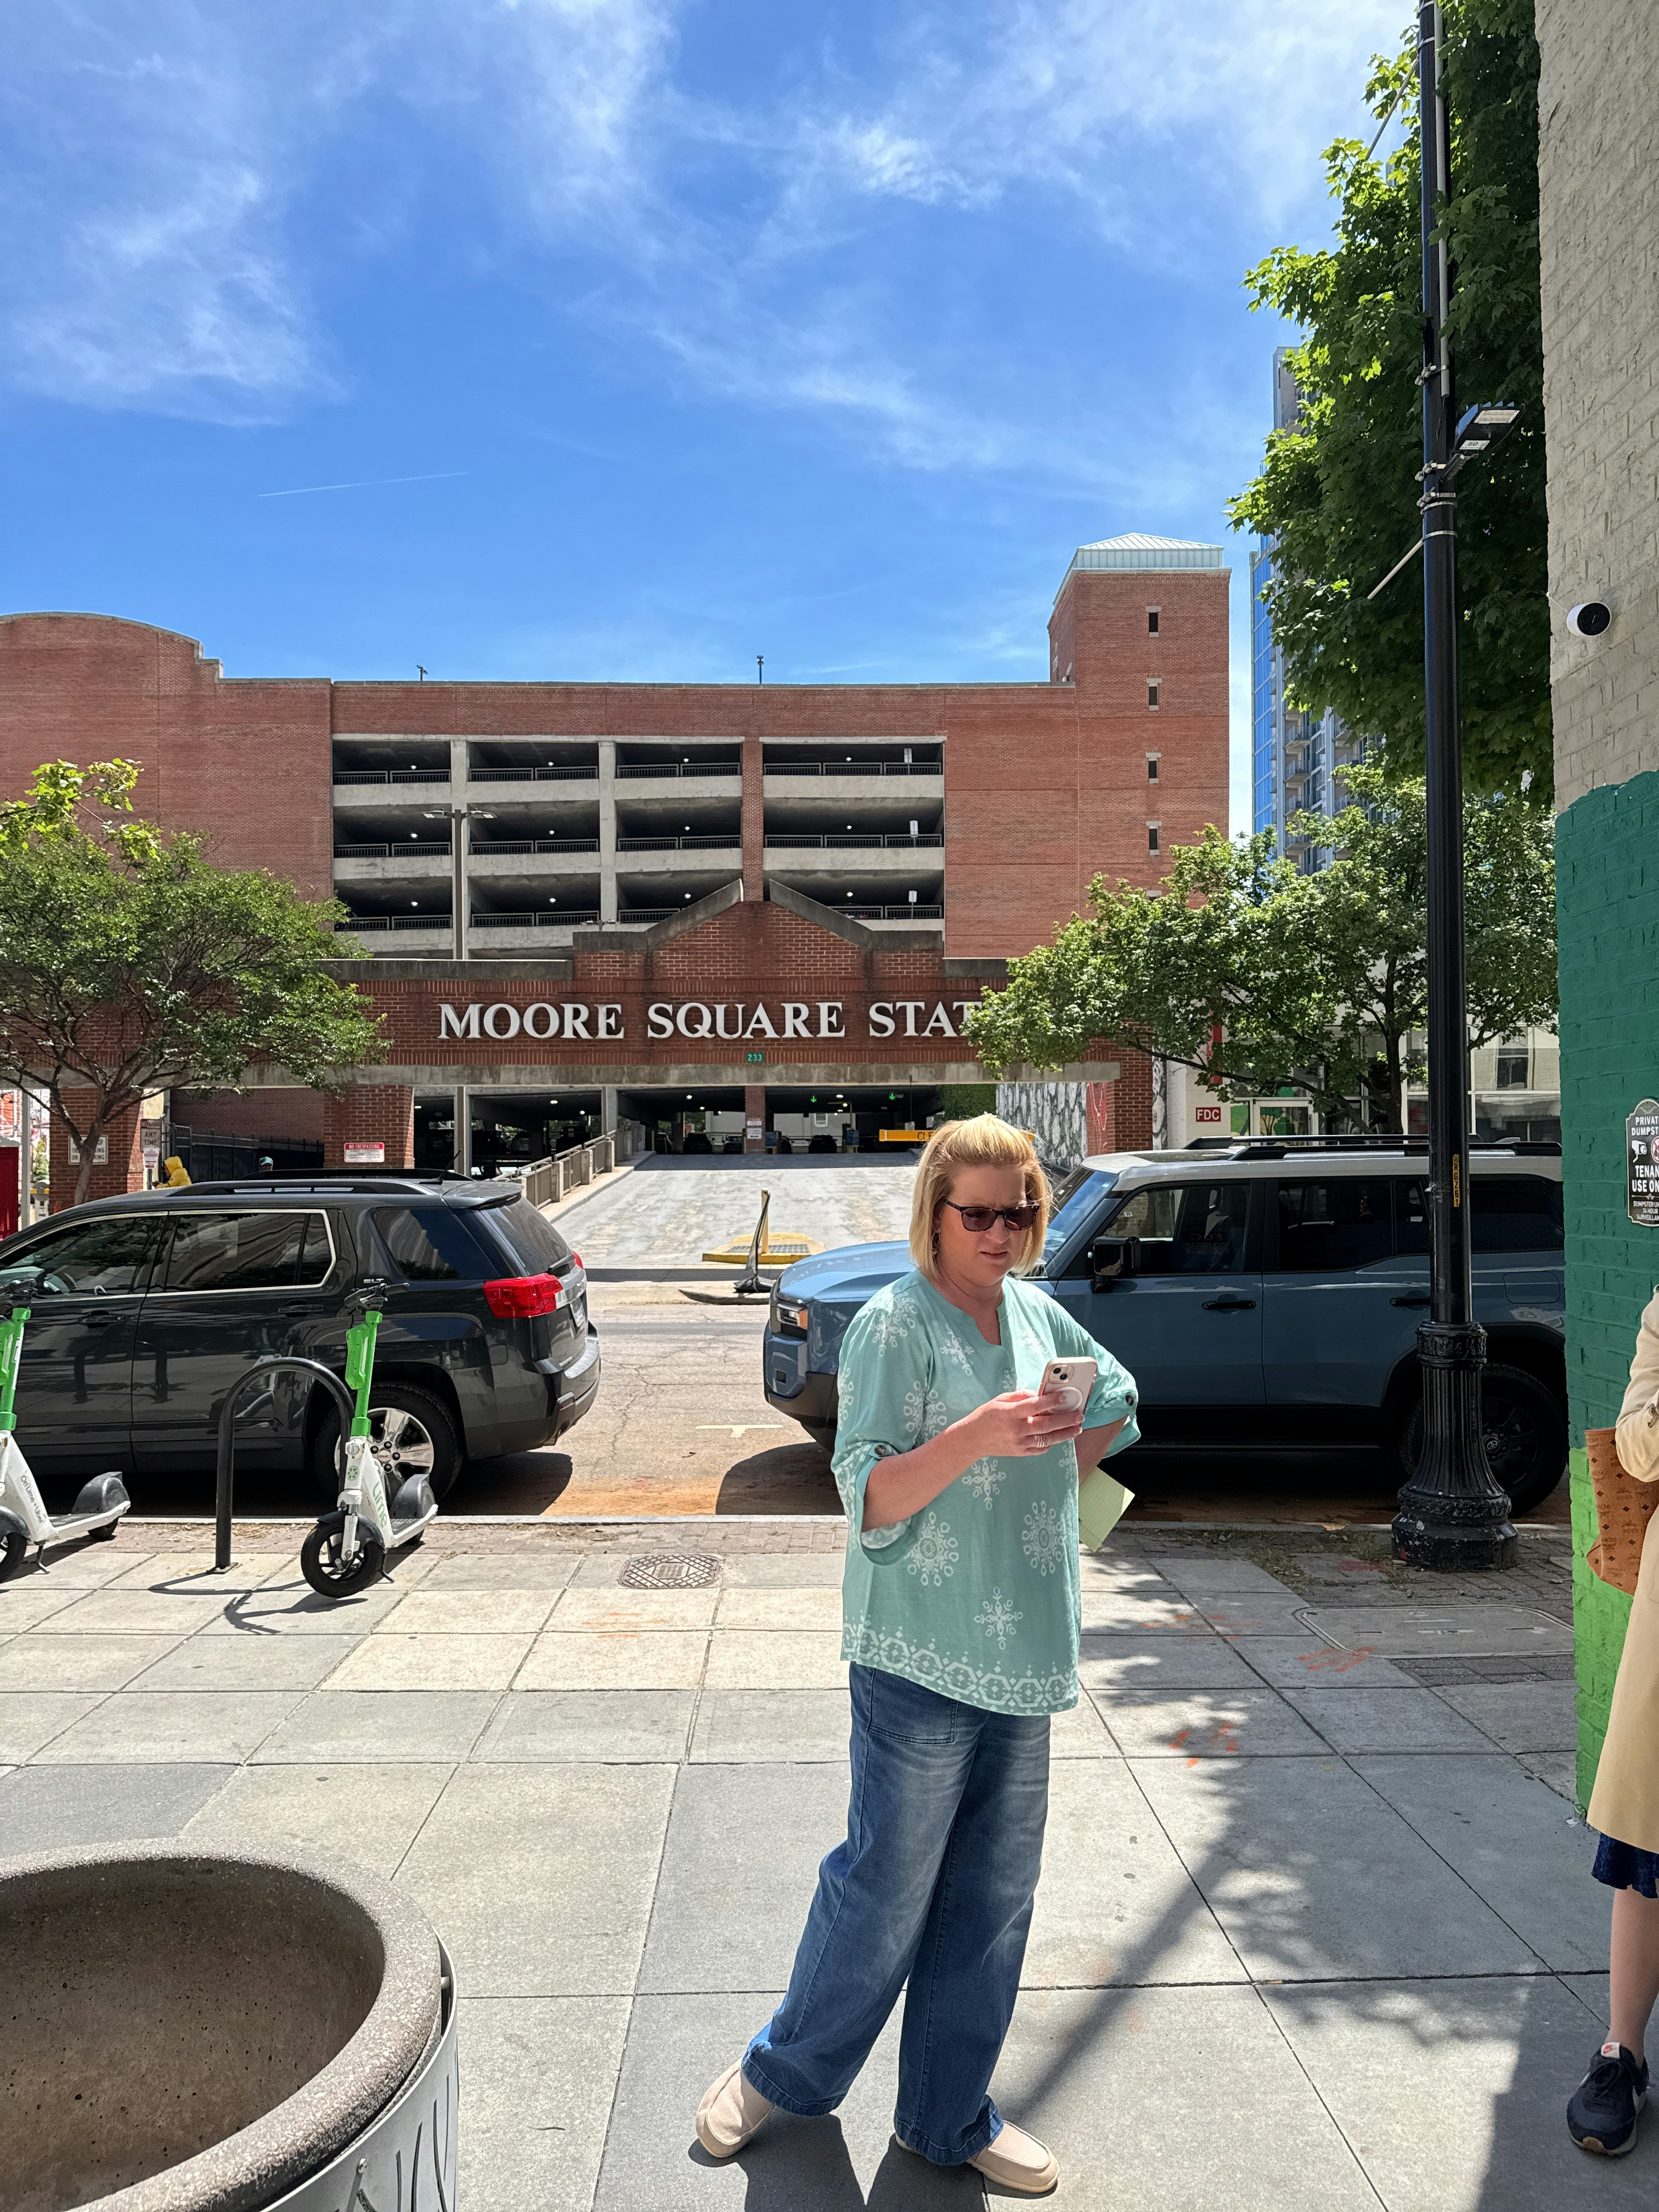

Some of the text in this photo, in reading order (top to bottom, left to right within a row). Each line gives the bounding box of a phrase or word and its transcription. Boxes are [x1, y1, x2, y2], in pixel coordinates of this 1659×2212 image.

[437, 1003, 624, 1039] MOORE
[647, 1002, 845, 1040] SQUARE
[747, 1053, 763, 1062] 233
[1197, 1109, 1220, 1120] FDC
[1635, 1116, 1659, 1125] PRIVAT
[1632, 1126, 1659, 1136] DUMPST
[1632, 1180, 1647, 1193] USE
[21, 1476, 28, 1487] On
[373, 1480, 387, 1528] Lime
